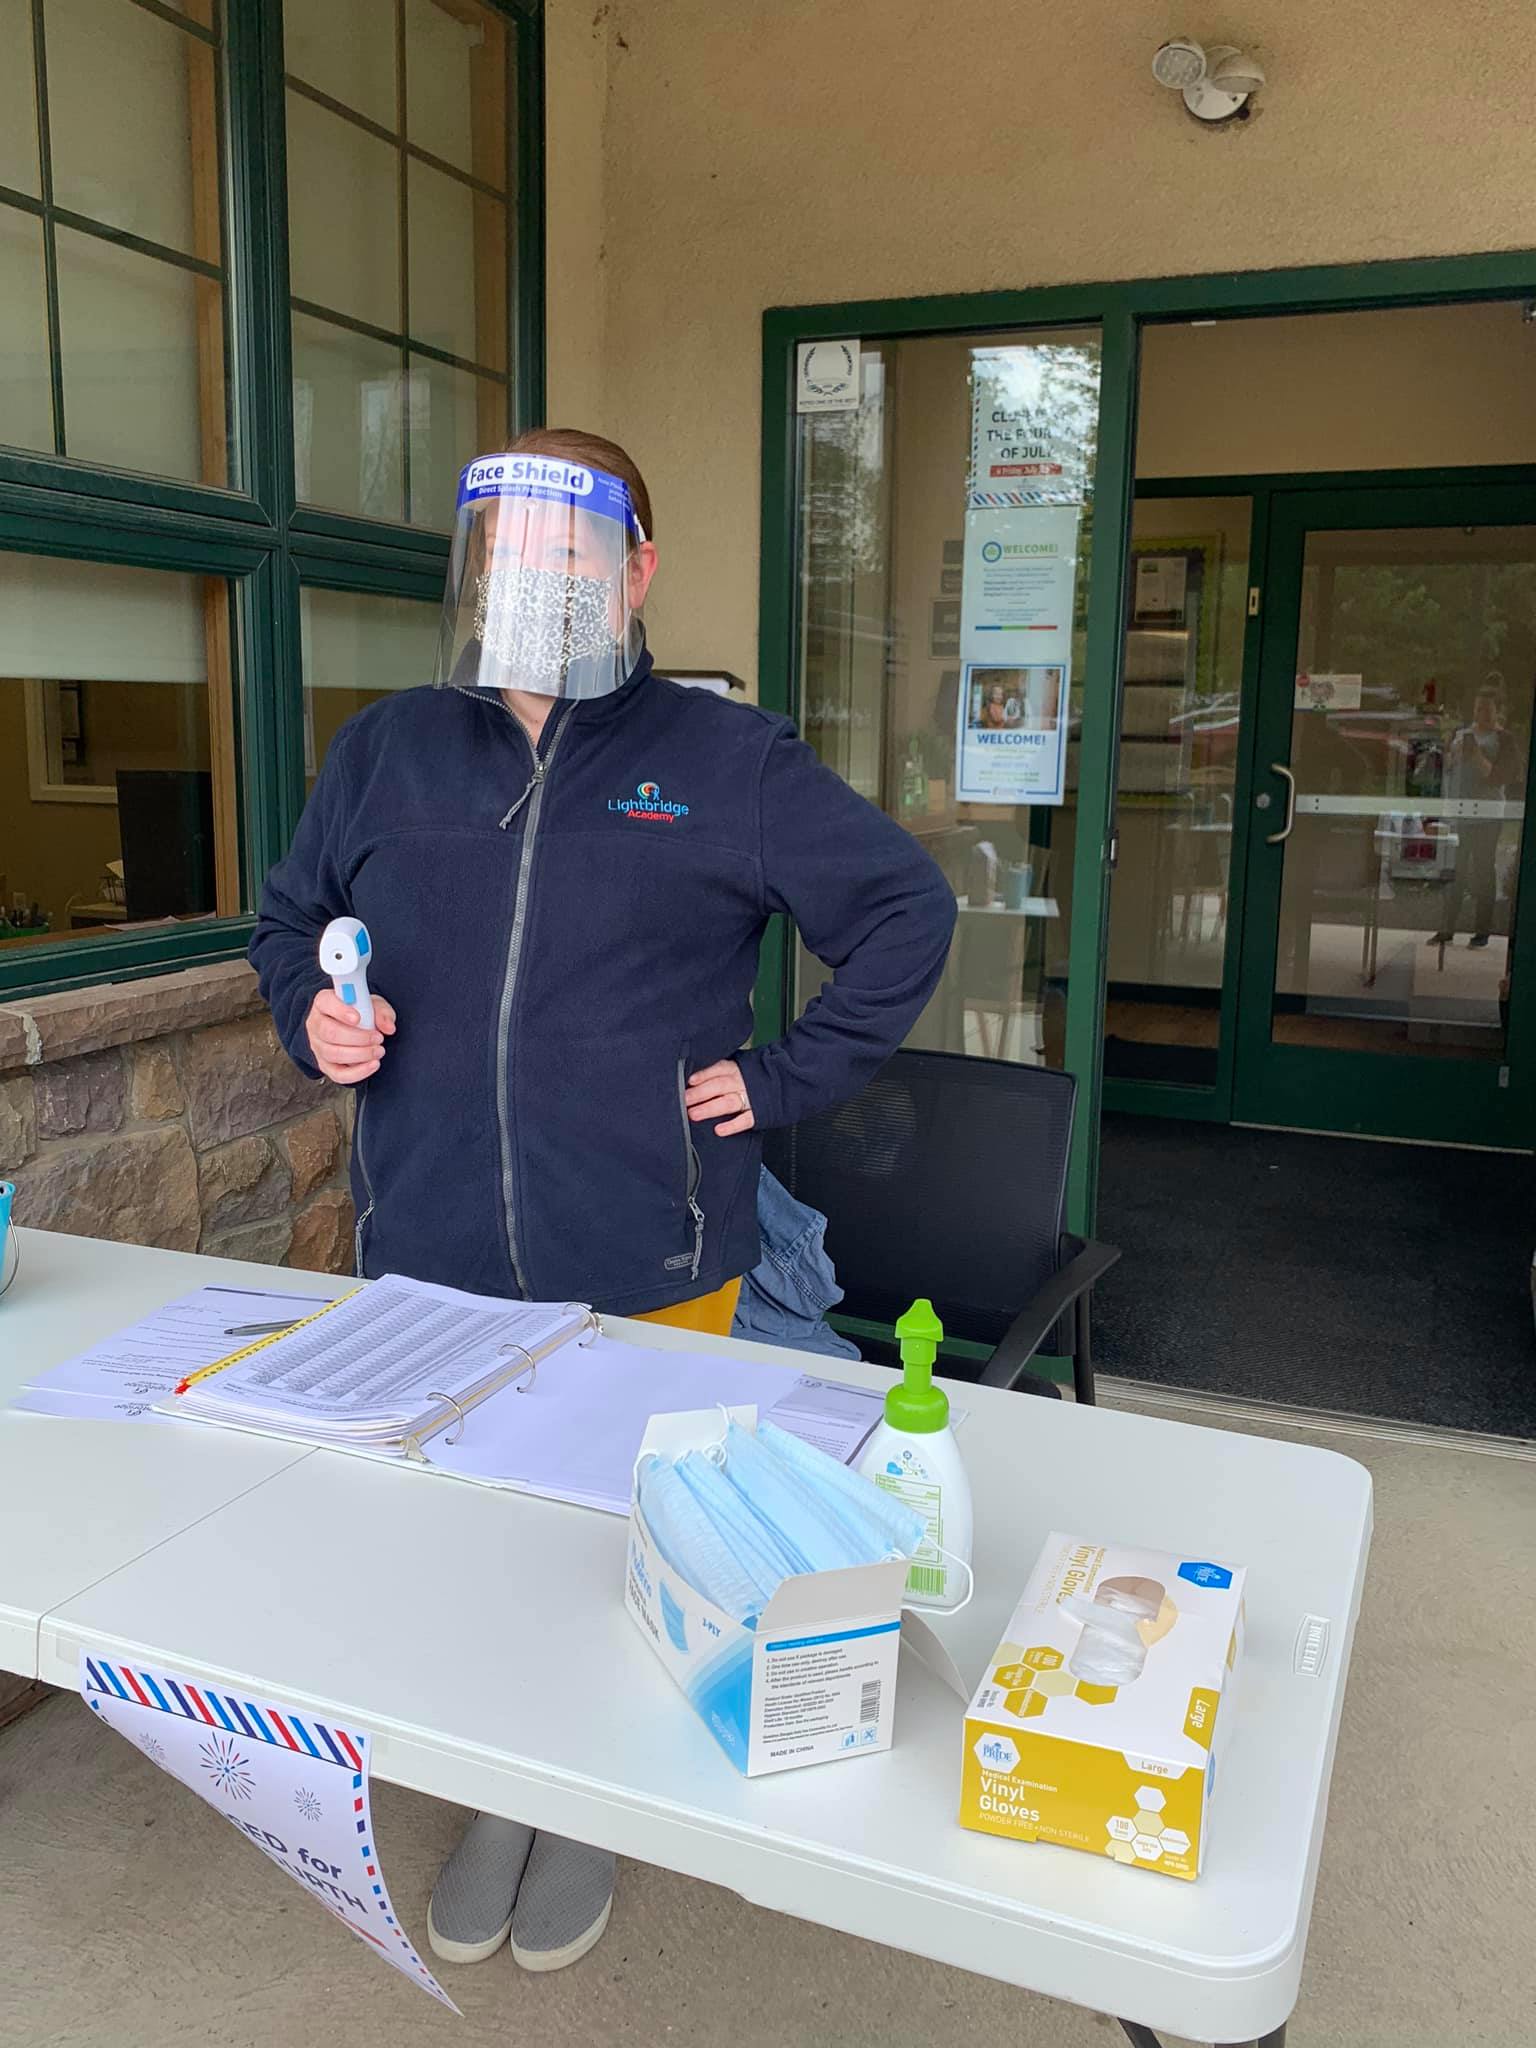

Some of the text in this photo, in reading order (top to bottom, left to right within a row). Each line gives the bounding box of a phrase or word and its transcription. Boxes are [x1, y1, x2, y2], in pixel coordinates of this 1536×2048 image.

[1001, 448, 1018, 459] OF
[470, 462, 585, 489] Face Shield
[1004, 544, 1058, 554] WELCOME!
[977, 733, 1046, 745] WELCOME!
[608, 798, 689, 816] Lightbridge
[628, 809, 674, 823] Academy
[1069, 1545, 1097, 1568] Vinyl
[1190, 1699, 1211, 1728] Large
[771, 1745, 814, 1757] MADE IN CHINA
[1141, 1761, 1168, 1774] Large
[981, 1776, 1025, 1802] Vinyl
[982, 1769, 1058, 1793] Medical Examination
[979, 1795, 1040, 1822] Gloves
[297, 1848, 342, 1879] for
